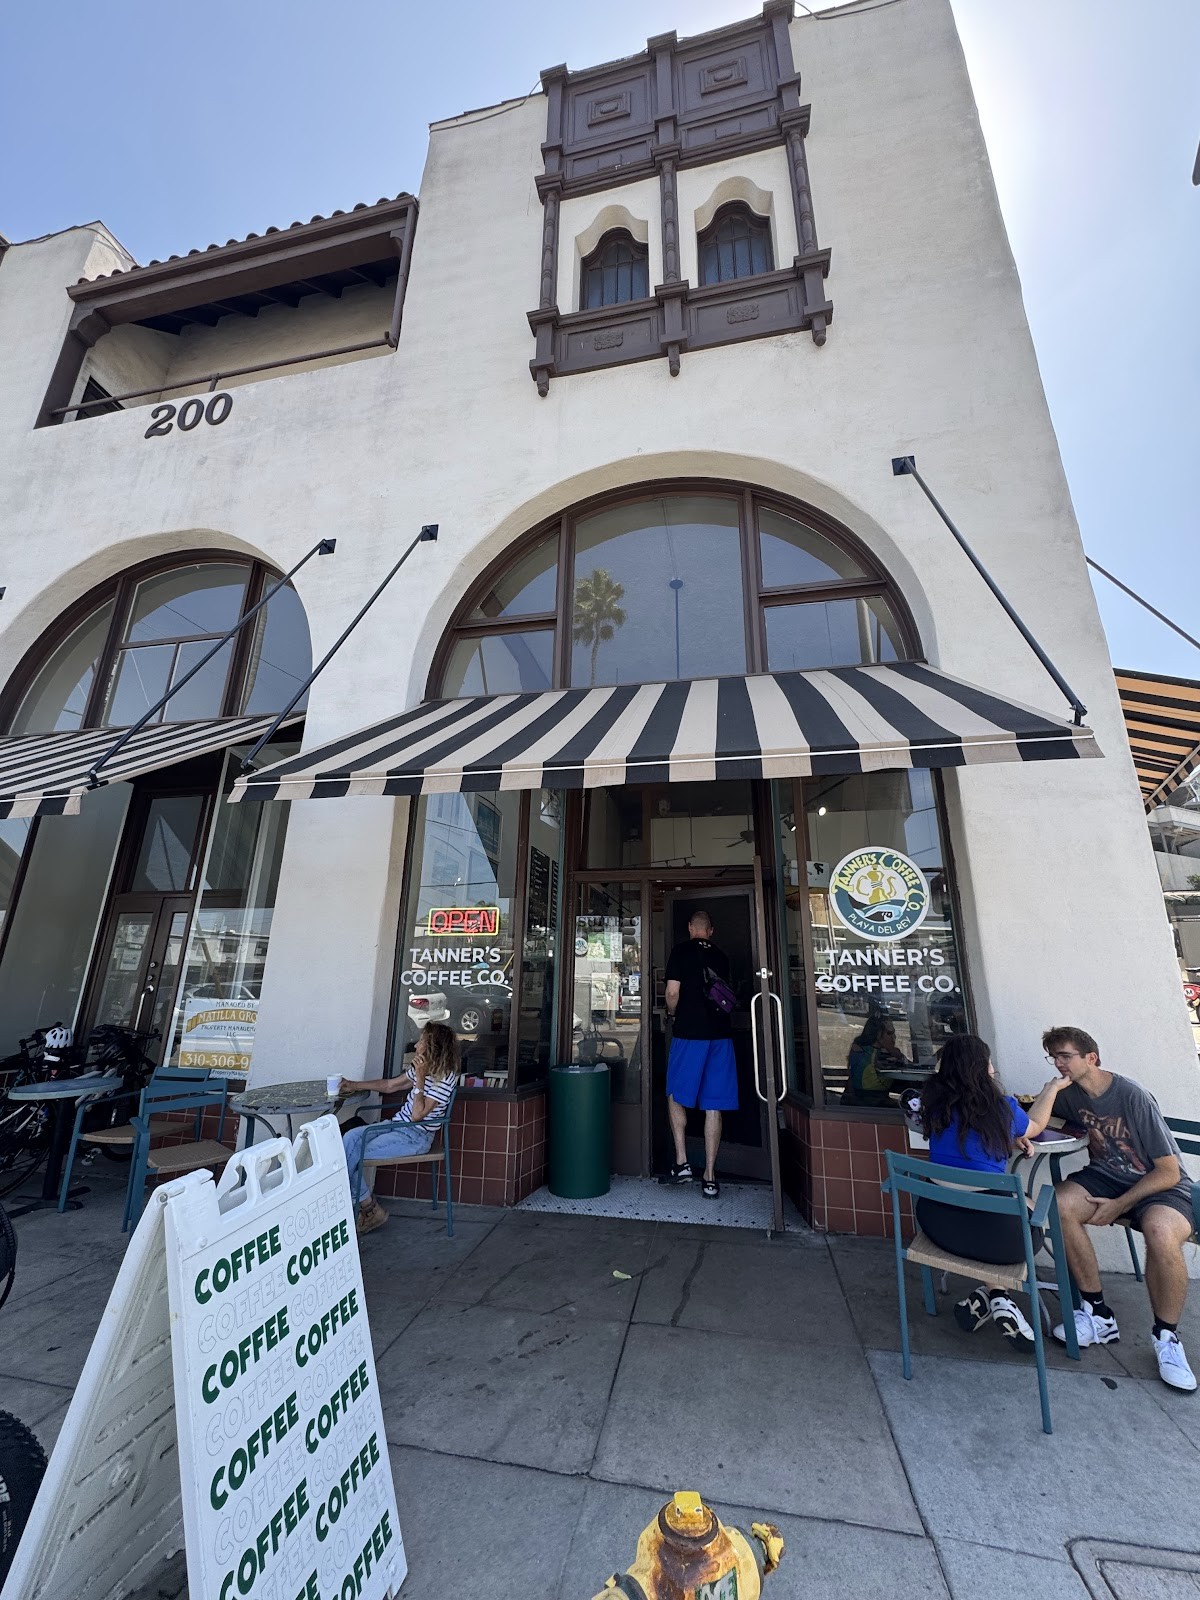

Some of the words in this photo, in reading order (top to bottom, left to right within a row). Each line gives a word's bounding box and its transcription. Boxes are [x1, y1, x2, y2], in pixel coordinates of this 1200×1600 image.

[144, 393, 233, 439] 200
[831, 854, 877, 894] TANNER'S
[878, 850, 921, 889] COFFEE
[904, 887, 929, 912] CO.
[431, 909, 496, 933] OPEN
[848, 914, 876, 933] PLAYA
[878, 925, 896, 934] DEL
[897, 916, 912, 934] REY
[400, 970, 472, 986] COFFEE
[477, 970, 509, 986] CO.
[409, 946, 501, 963] TANNER'S
[816, 975, 911, 993] COFFEE
[917, 975, 961, 993] CO.
[825, 948, 945, 966] TANNER'S
[198, 1011, 236, 1023] MATILLA
[185, 1053, 249, 1068] 310-306-9
[282, 1185, 346, 1247] COFFEE
[195, 1224, 281, 1304] COFFEE
[286, 1219, 349, 1285] COFFEE
[202, 1305, 290, 1404] COFFEE
[295, 1288, 359, 1367] COFFEE
[305, 1360, 369, 1454] COFFEE
[210, 1390, 299, 1510] COFFEE
[315, 1431, 380, 1542] COFFEE
[219, 1477, 309, 1600] COFFEE
[332, 1509, 392, 1600] OFFEE
